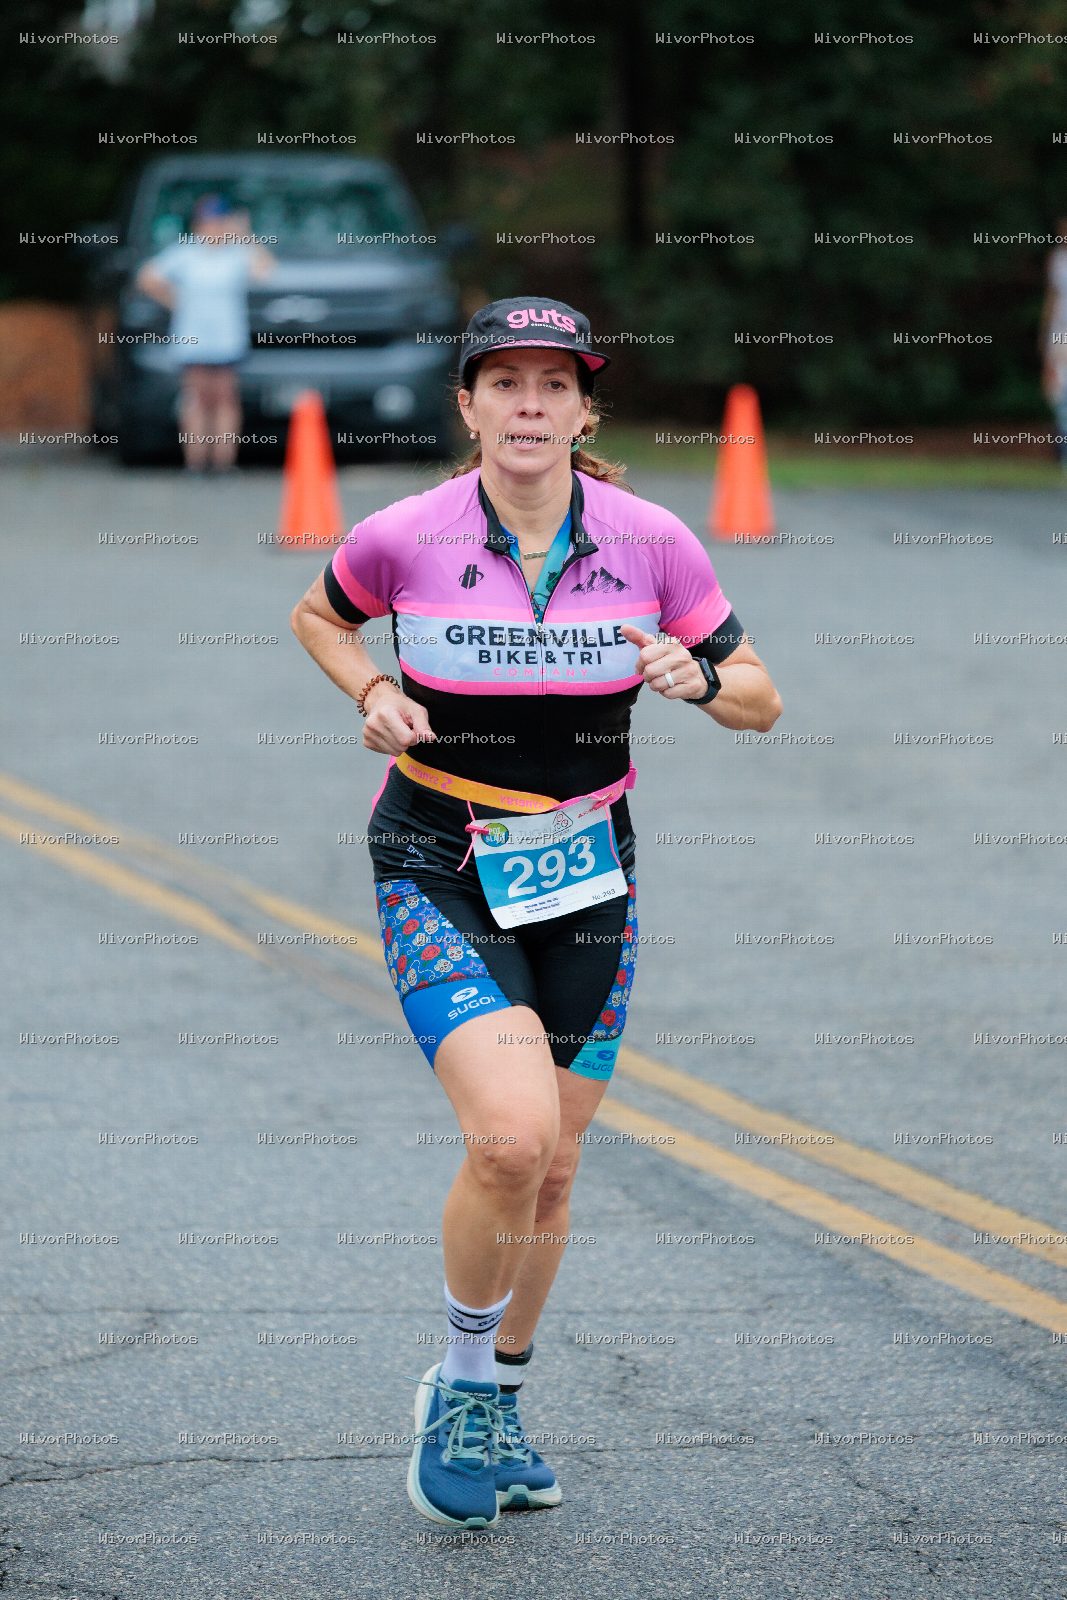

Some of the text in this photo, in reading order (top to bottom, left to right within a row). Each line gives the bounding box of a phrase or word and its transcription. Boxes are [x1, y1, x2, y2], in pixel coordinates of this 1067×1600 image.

[506, 308, 577, 334] guts
[445, 623, 628, 649] GREENVILLE
[478, 650, 602, 665] BIKE & TRI
[492, 667, 588, 678] COMPANY
[503, 836, 596, 899] 293
[592, 888, 616, 901] No.293
